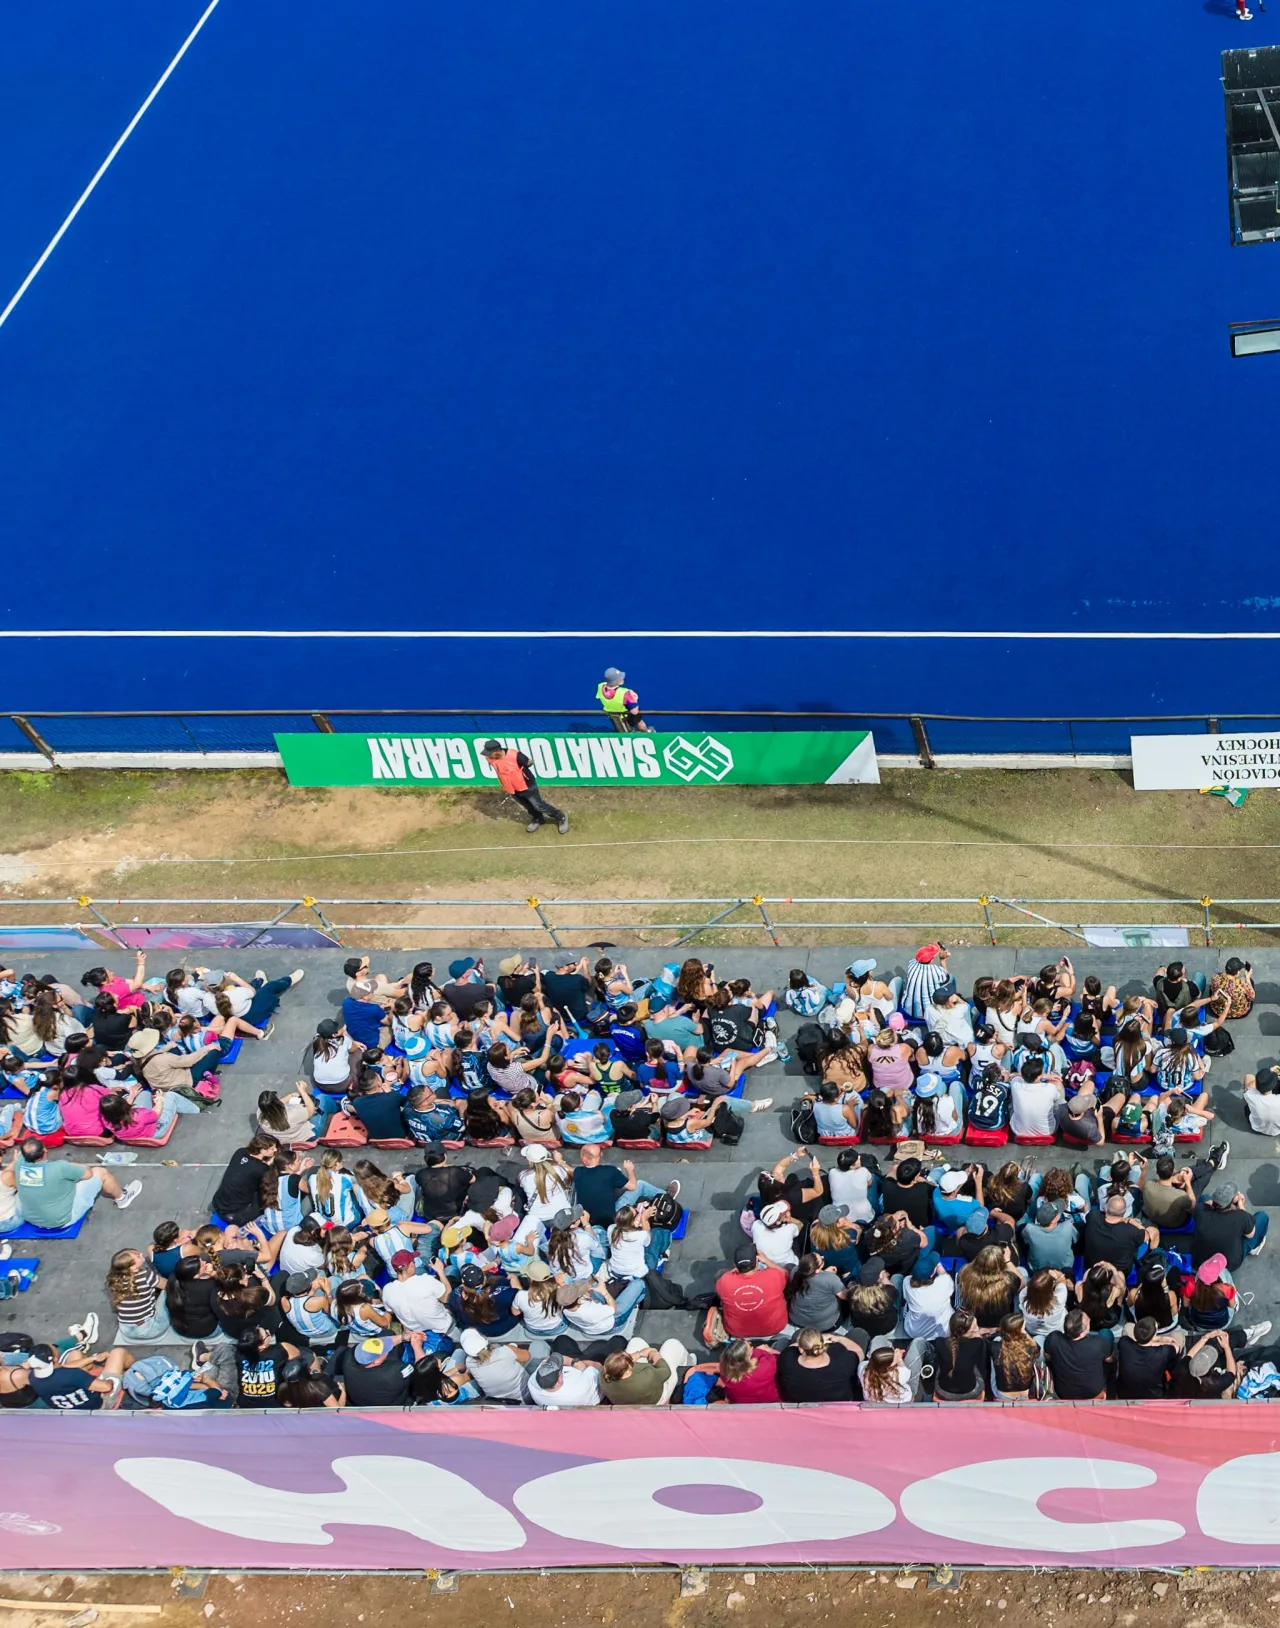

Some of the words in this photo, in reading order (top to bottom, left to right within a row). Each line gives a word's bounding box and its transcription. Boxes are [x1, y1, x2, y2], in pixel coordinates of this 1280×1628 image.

[1216, 739, 1280, 751] HOCKEY
[366, 737, 476, 779] GARAY
[473, 737, 661, 779] SANATOO
[976, 1080, 1003, 1099] MSSI
[974, 1091, 999, 1118] 19
[241, 1359, 274, 1371] 202
[241, 1382, 276, 1396] 2026
